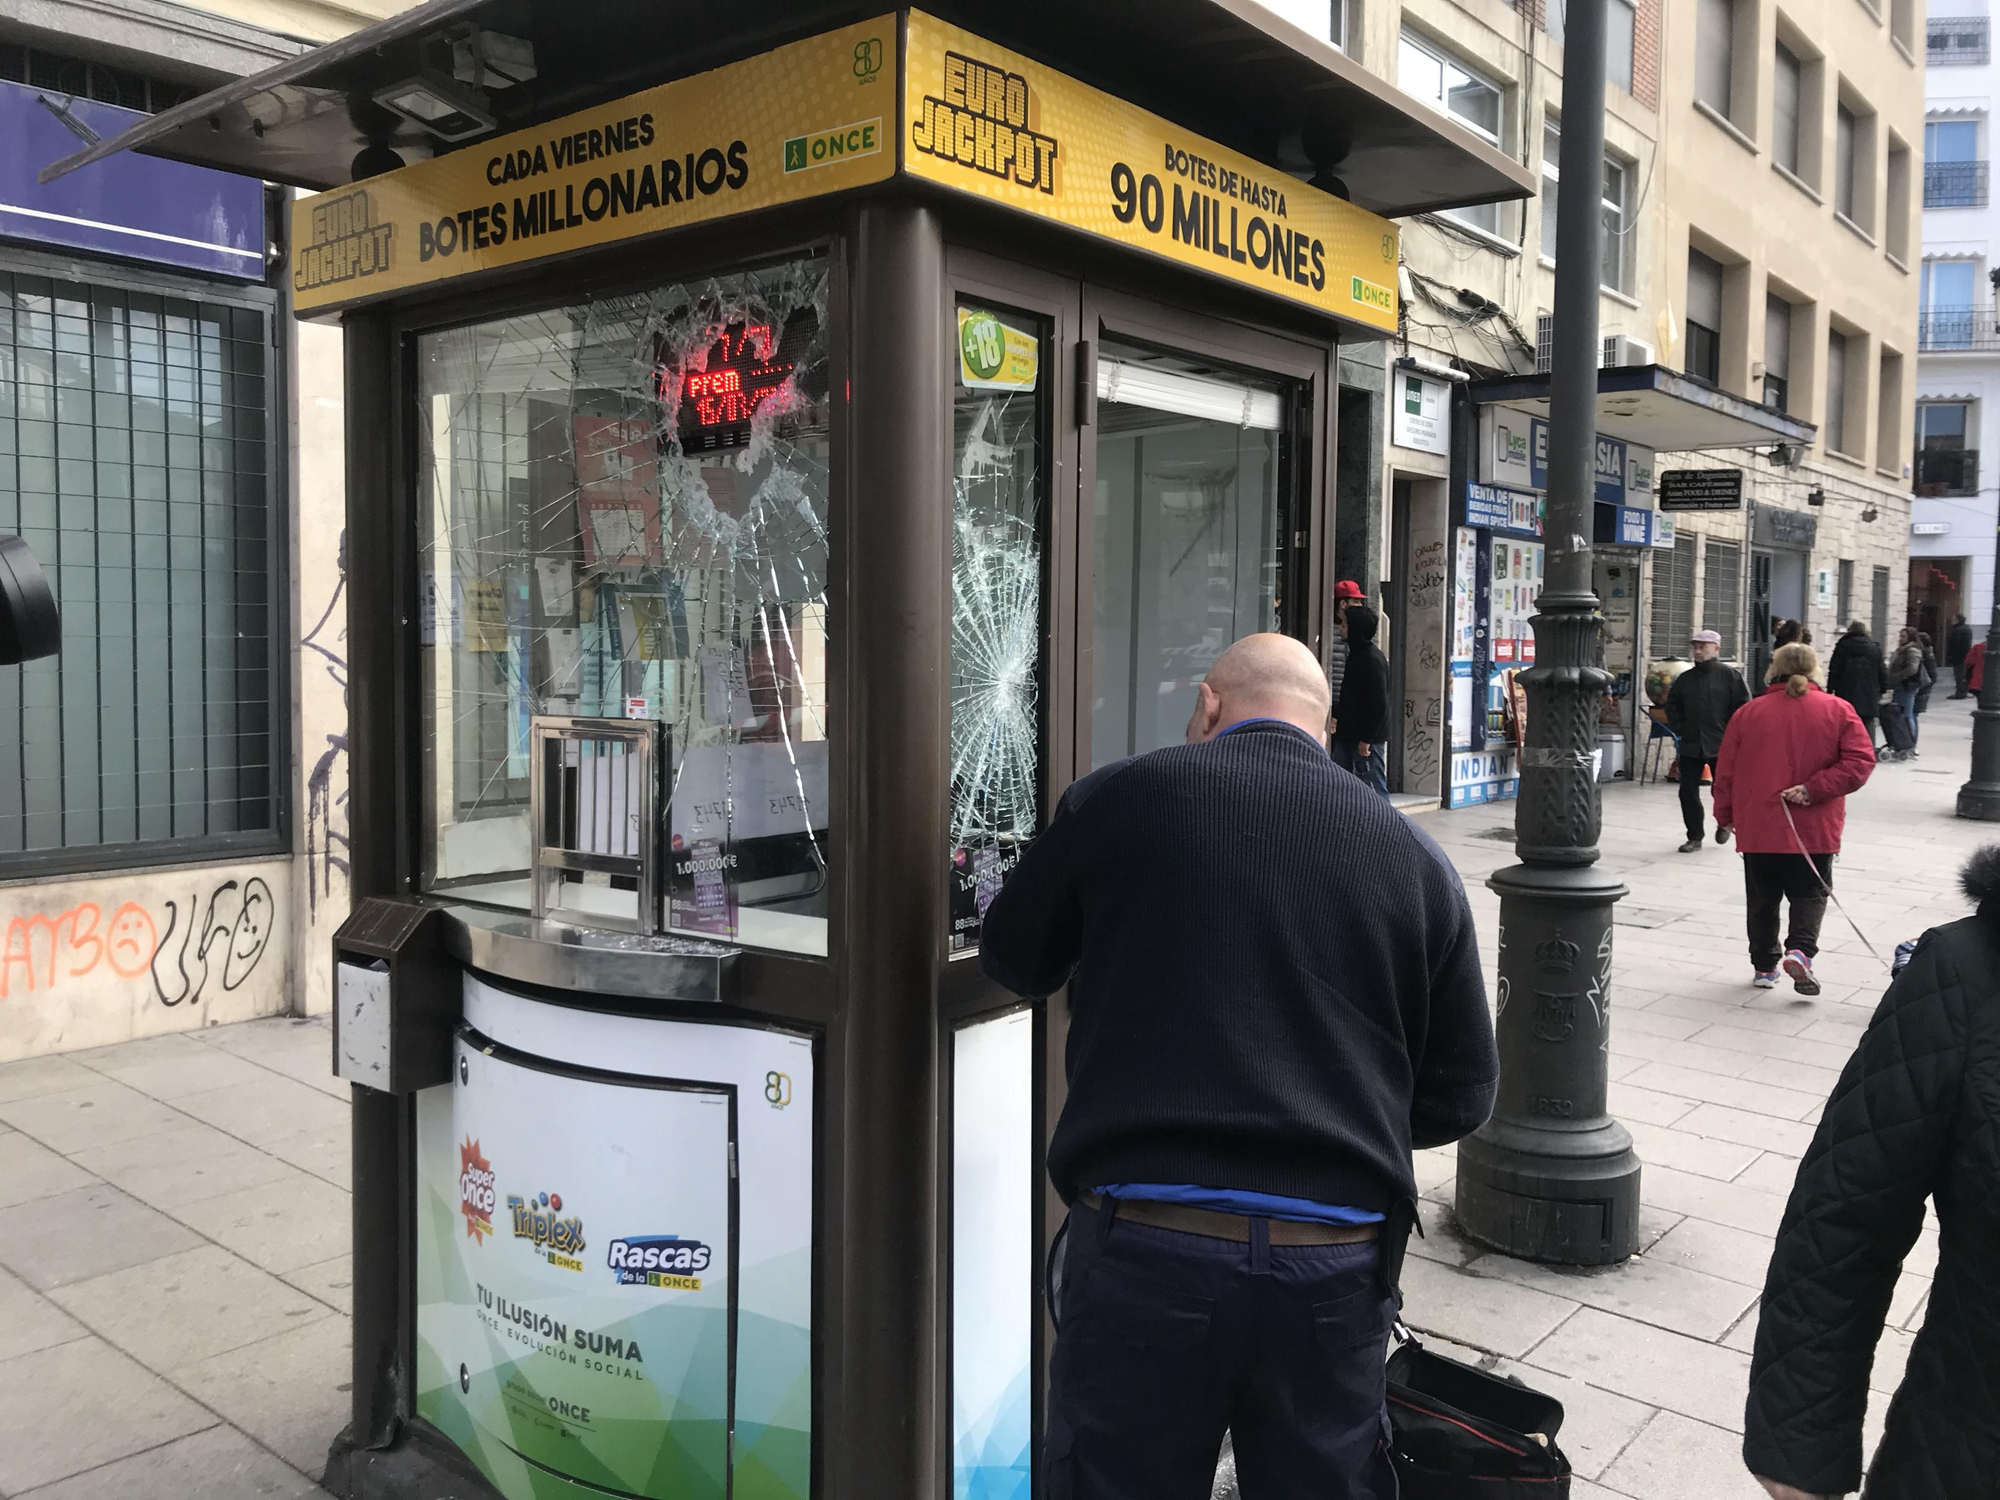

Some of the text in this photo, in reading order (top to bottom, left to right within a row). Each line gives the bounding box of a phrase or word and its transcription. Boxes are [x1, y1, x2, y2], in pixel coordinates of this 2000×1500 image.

[853, 38, 882, 77] 80
[944, 50, 1029, 132] EURO
[487, 113, 655, 187] CADA VIERNES
[811, 125, 876, 161] ONCE
[912, 95, 1057, 194] JACKPOT
[1165, 143, 1288, 220] BOTES DE HASTA
[312, 189, 368, 246] EURO
[419, 140, 749, 263] BOTES MILLONARIOS
[1110, 162, 1326, 293] 90 MILLONES
[294, 222, 392, 292] JACKPOT
[1381, 234, 1395, 260] 80
[1364, 285, 1391, 309] ONCE
[1469, 484, 1508, 505] VENTA DE
[1469, 500, 1492, 513] BEBIDAS
[1469, 512, 1508, 528] INDIAN SPICE
[1623, 511, 1640, 525] FOOD
[1623, 524, 1645, 543] WINE
[1454, 754, 1508, 781] INDIAN
[676, 855, 738, 875] 1.000.000€
[959, 854, 1016, 891] 1.000.000€
[764, 1070, 792, 1106] 80
[461, 1173, 496, 1213] Once
[467, 1162, 495, 1188] Super
[507, 1194, 586, 1256] Triplex
[556, 1256, 582, 1271] ONCE
[608, 1241, 710, 1269] Rascas
[622, 1270, 699, 1290] de la ONCE
[476, 1283, 643, 1363] TU ILUSIÓN SUMA
[507, 1328, 577, 1364] EVOLUCIÓN
[585, 1359, 643, 1380] SOCIAL
[548, 1397, 590, 1423] ONCE
